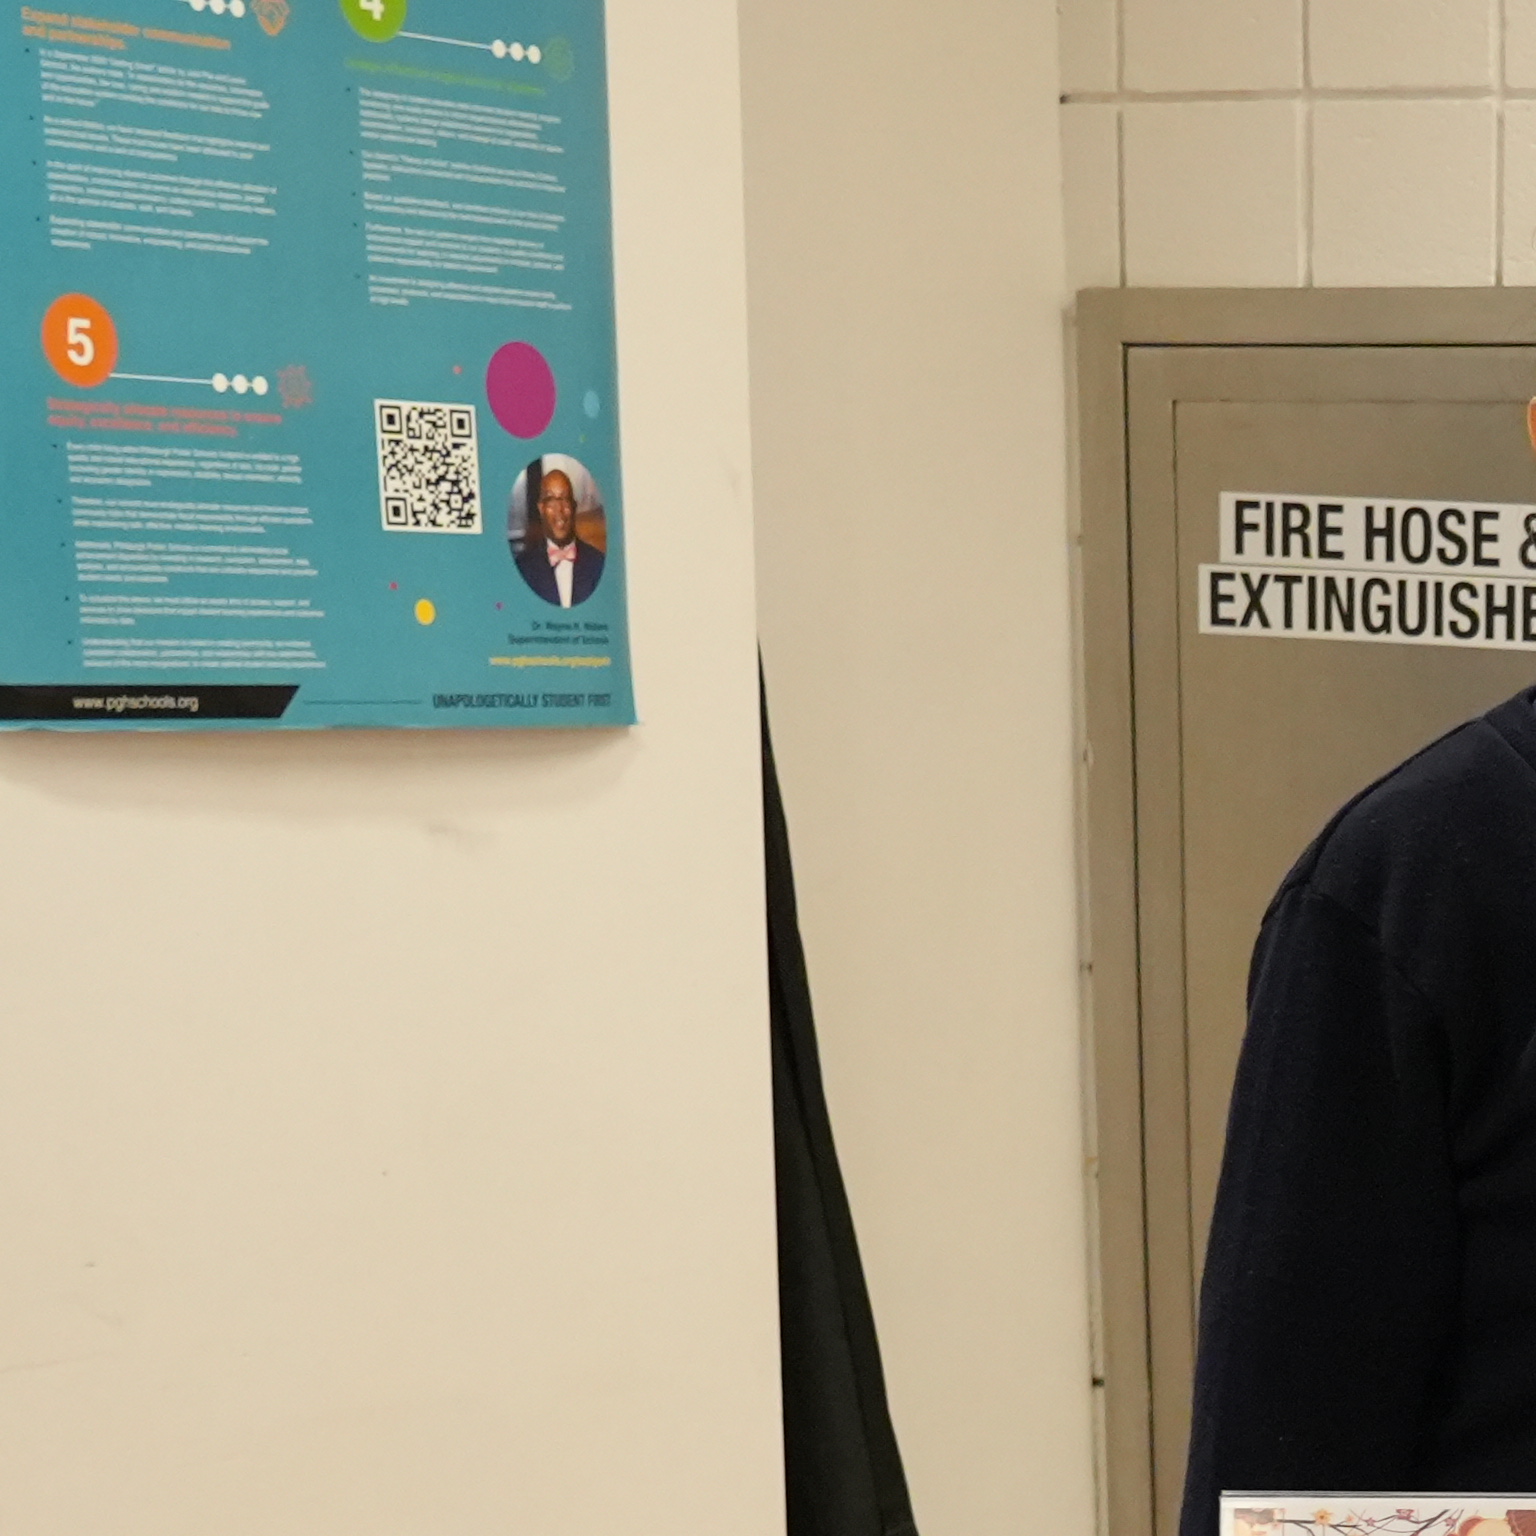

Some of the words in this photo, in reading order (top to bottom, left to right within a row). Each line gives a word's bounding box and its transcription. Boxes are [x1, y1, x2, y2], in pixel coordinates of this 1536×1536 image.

[67, 318, 94, 366] 5
[1234, 500, 1344, 560] FIRE
[1365, 506, 1500, 567] HOSE
